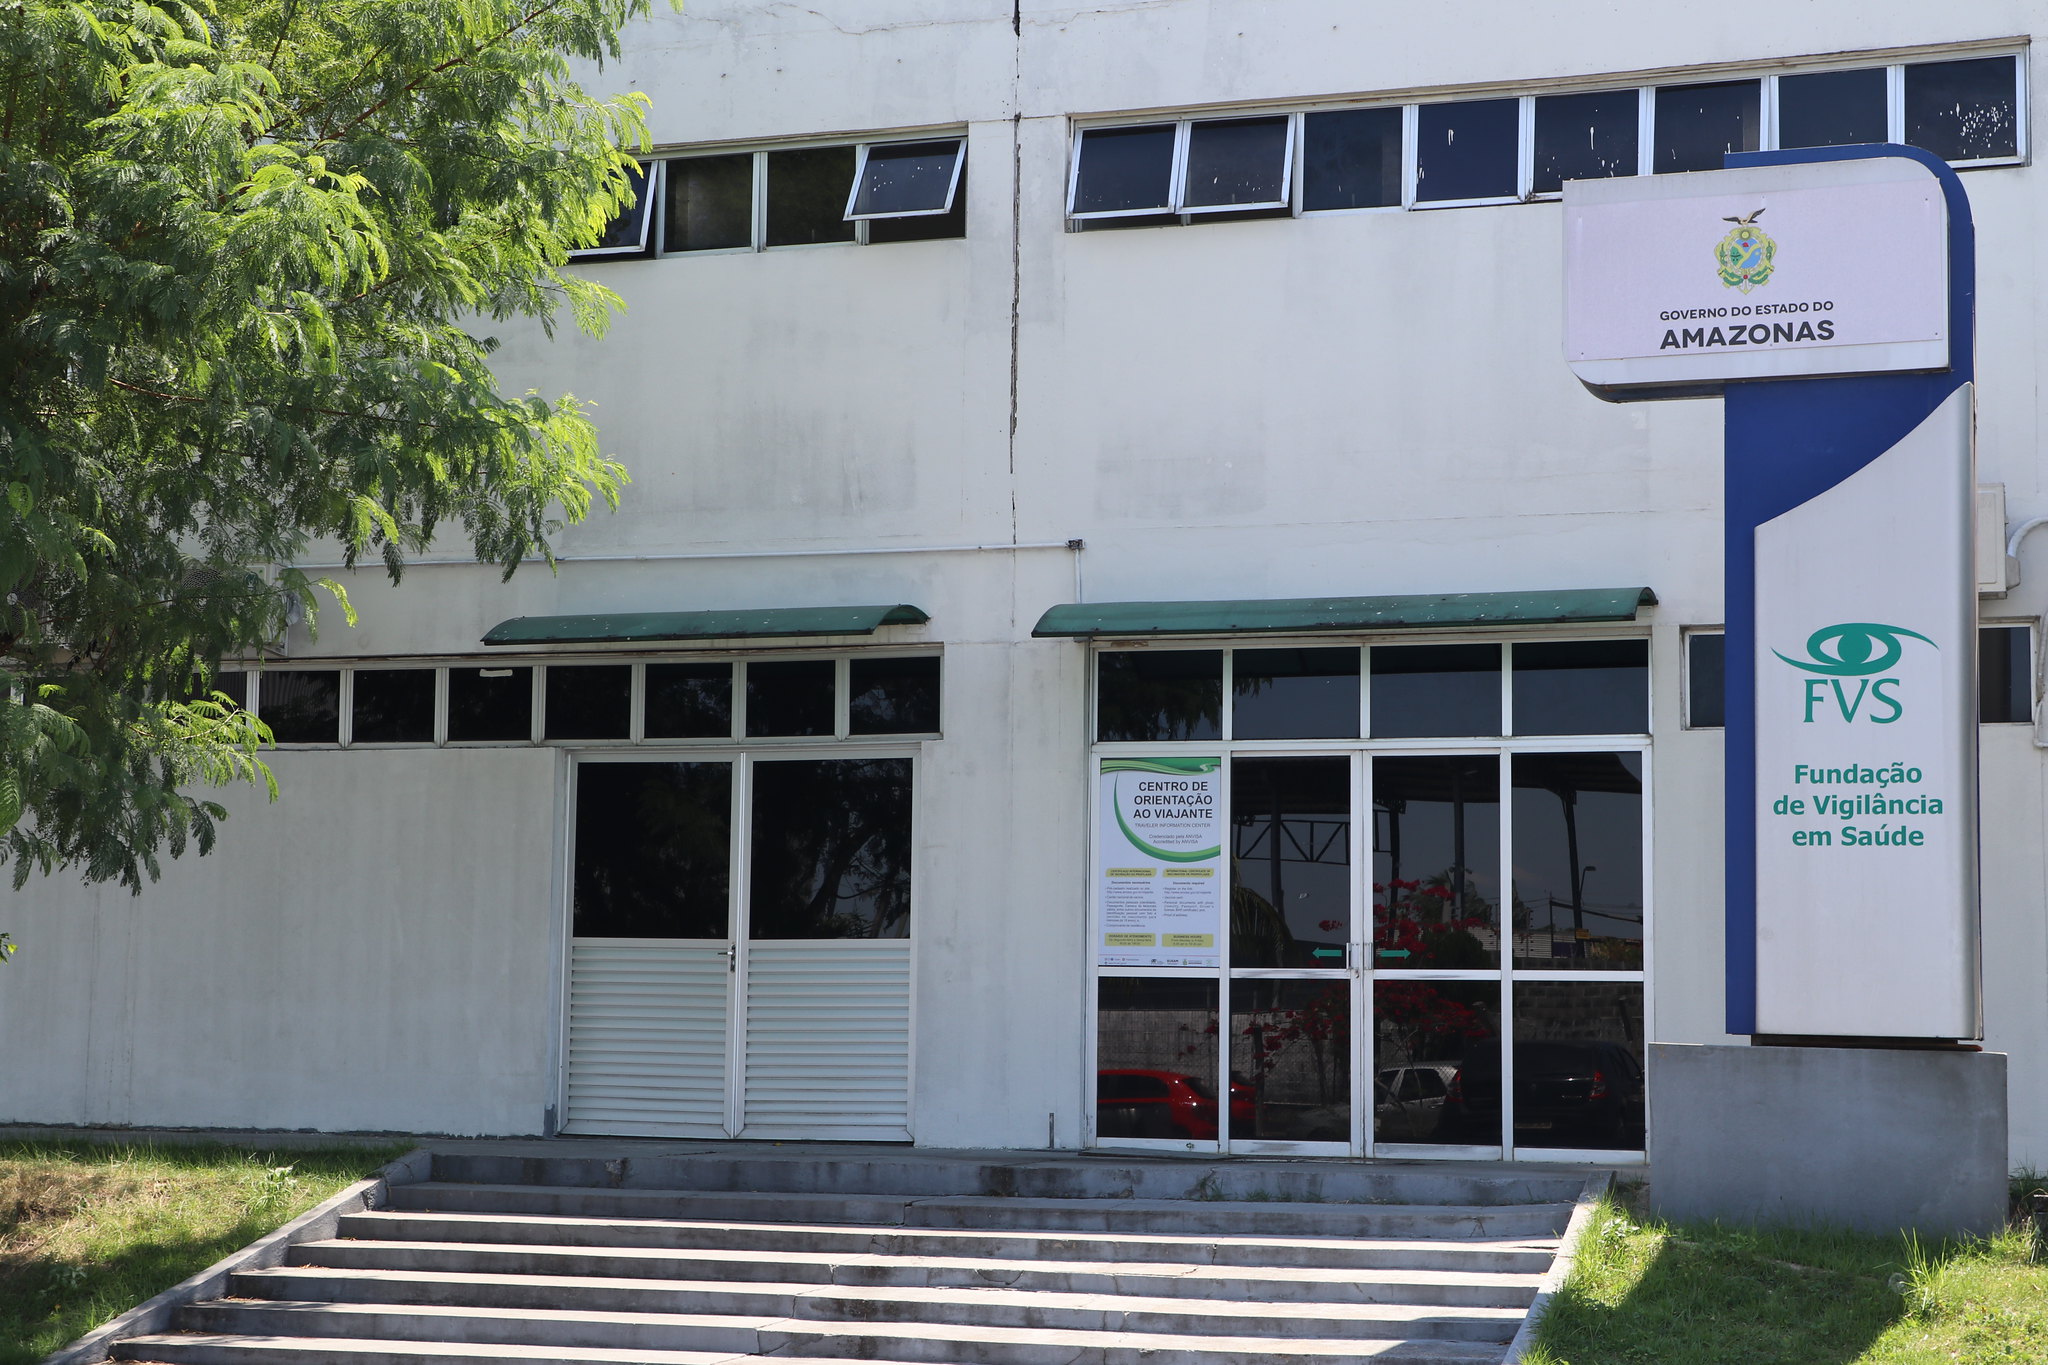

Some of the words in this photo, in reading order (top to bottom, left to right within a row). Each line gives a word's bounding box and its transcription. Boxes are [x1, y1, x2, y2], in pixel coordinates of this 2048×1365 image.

[1659, 307, 1727, 320] GOVERNO
[1731, 306, 1751, 316] DO
[1755, 303, 1809, 315] ESTADO
[1813, 301, 1834, 311] DO
[1659, 320, 1835, 350] AMAZONAS
[1803, 678, 1903, 724] FVS
[1795, 762, 1922, 788] Fundação
[1138, 781, 1189, 792] CENTRO
[1192, 781, 1208, 791] DE
[1134, 793, 1213, 807] ORIENTAÇÃO
[1773, 795, 1805, 815] de
[1812, 793, 1943, 820] Vigilância
[1133, 809, 1151, 819] AO
[1154, 809, 1213, 819] VIAJANTE
[1792, 830, 1832, 846] em
[1841, 824, 1924, 846] Saúde
